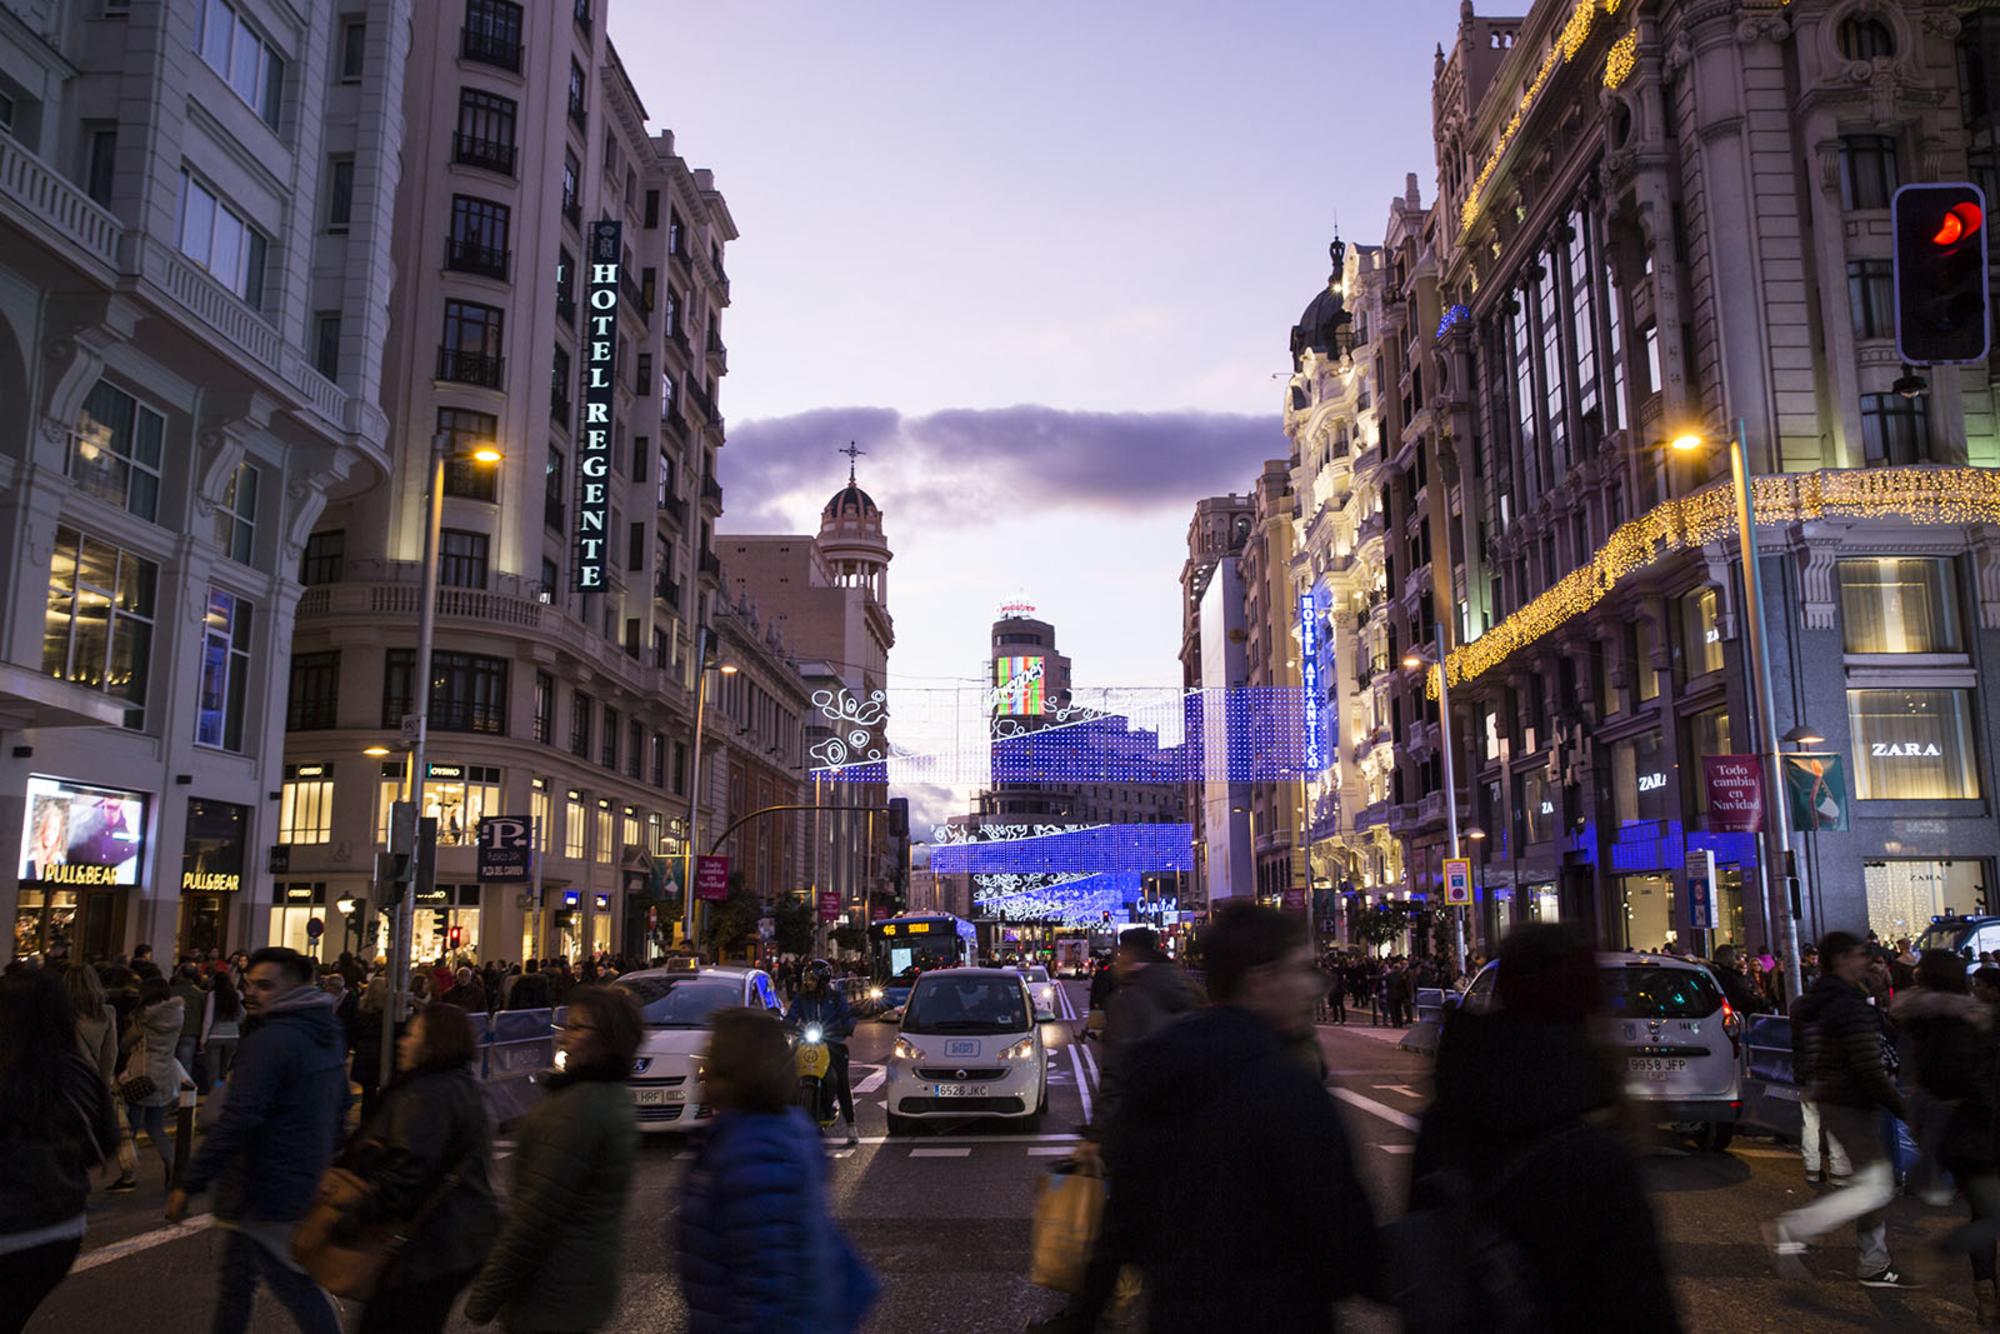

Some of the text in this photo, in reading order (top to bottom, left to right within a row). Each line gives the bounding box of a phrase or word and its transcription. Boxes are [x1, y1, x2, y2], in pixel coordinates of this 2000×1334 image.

[591, 264, 618, 388] HOTEL
[581, 402, 609, 587] REGENTE
[1302, 597, 1315, 656] HOTEL
[1872, 743, 1941, 757] ZARA
[1716, 765, 1748, 775] Todo
[1713, 777, 1755, 787] cambia
[1713, 799, 1760, 810] Navidad
[487, 822, 525, 849] P
[45, 864, 119, 886] PULL&BEAR
[183, 872, 240, 892] PULL&BEAR
[883, 924, 896, 936] 46
[1665, 1060, 1686, 1070] JFP
[940, 1086, 986, 1096] 6526 JKC
